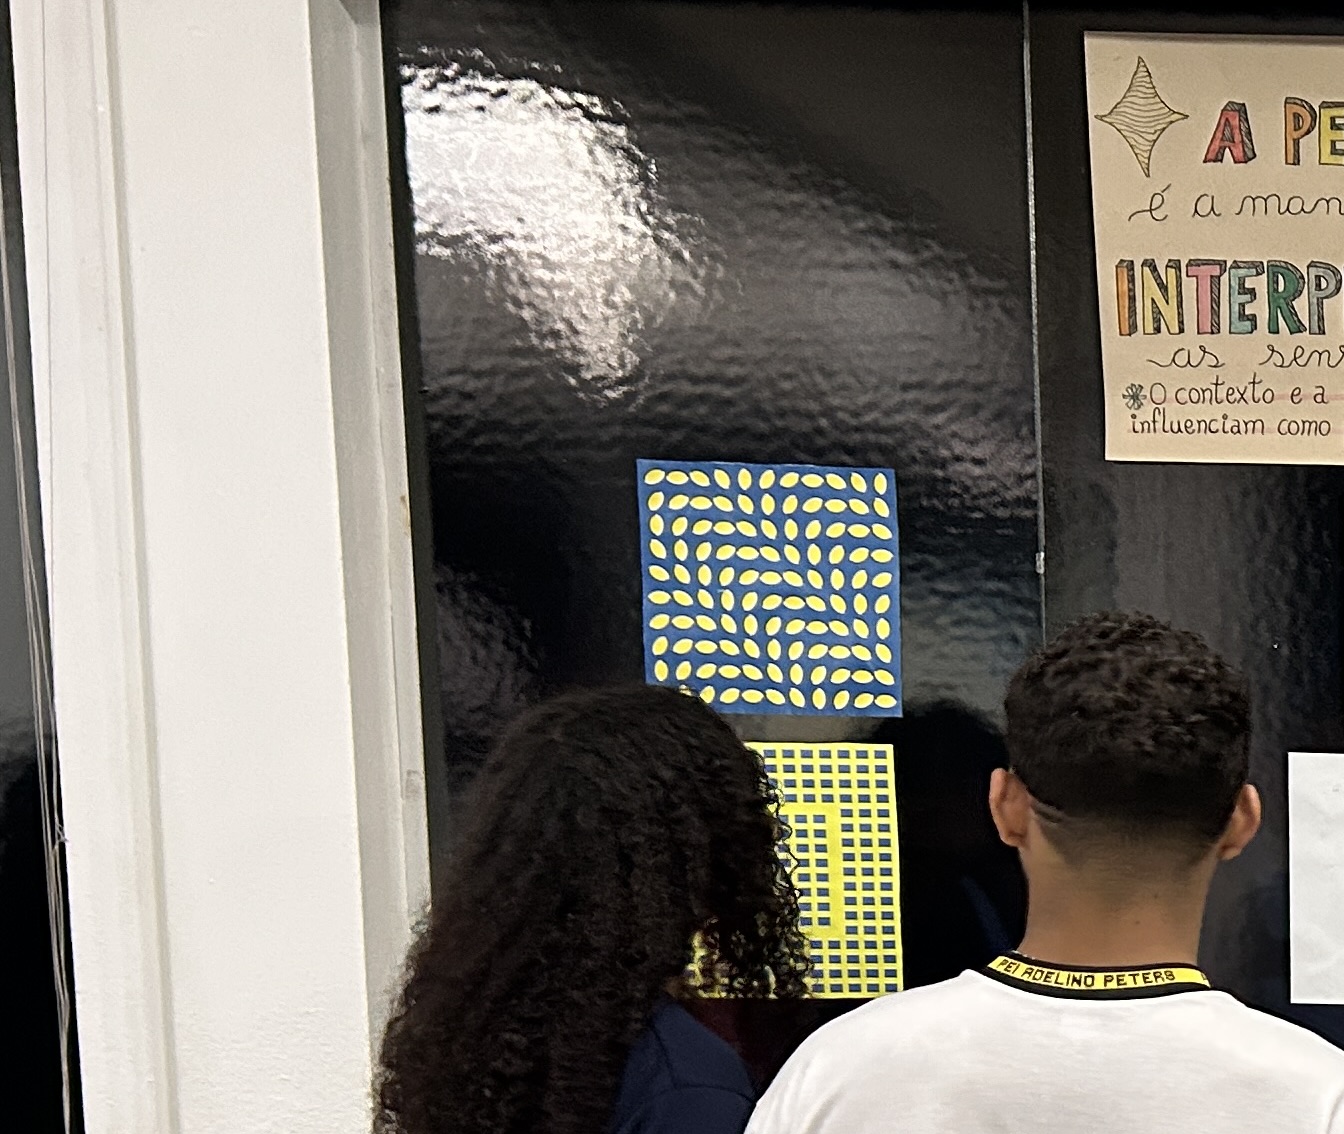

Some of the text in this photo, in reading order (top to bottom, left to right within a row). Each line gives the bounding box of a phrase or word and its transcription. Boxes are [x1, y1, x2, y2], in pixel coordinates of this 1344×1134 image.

[1203, 100, 1257, 165] A
[1128, 183, 1172, 222] é
[1191, 193, 1223, 218] a
[1146, 344, 1226, 369] as
[1149, 382, 1168, 406] O
[1174, 372, 1276, 406] contexto
[1290, 385, 1303, 405] e
[1313, 384, 1329, 405] a
[1130, 407, 1266, 436] influenciam
[1277, 418, 1332, 437] como
[1020, 967, 1097, 989] ADELINO
[1103, 970, 1177, 989] PETERS
